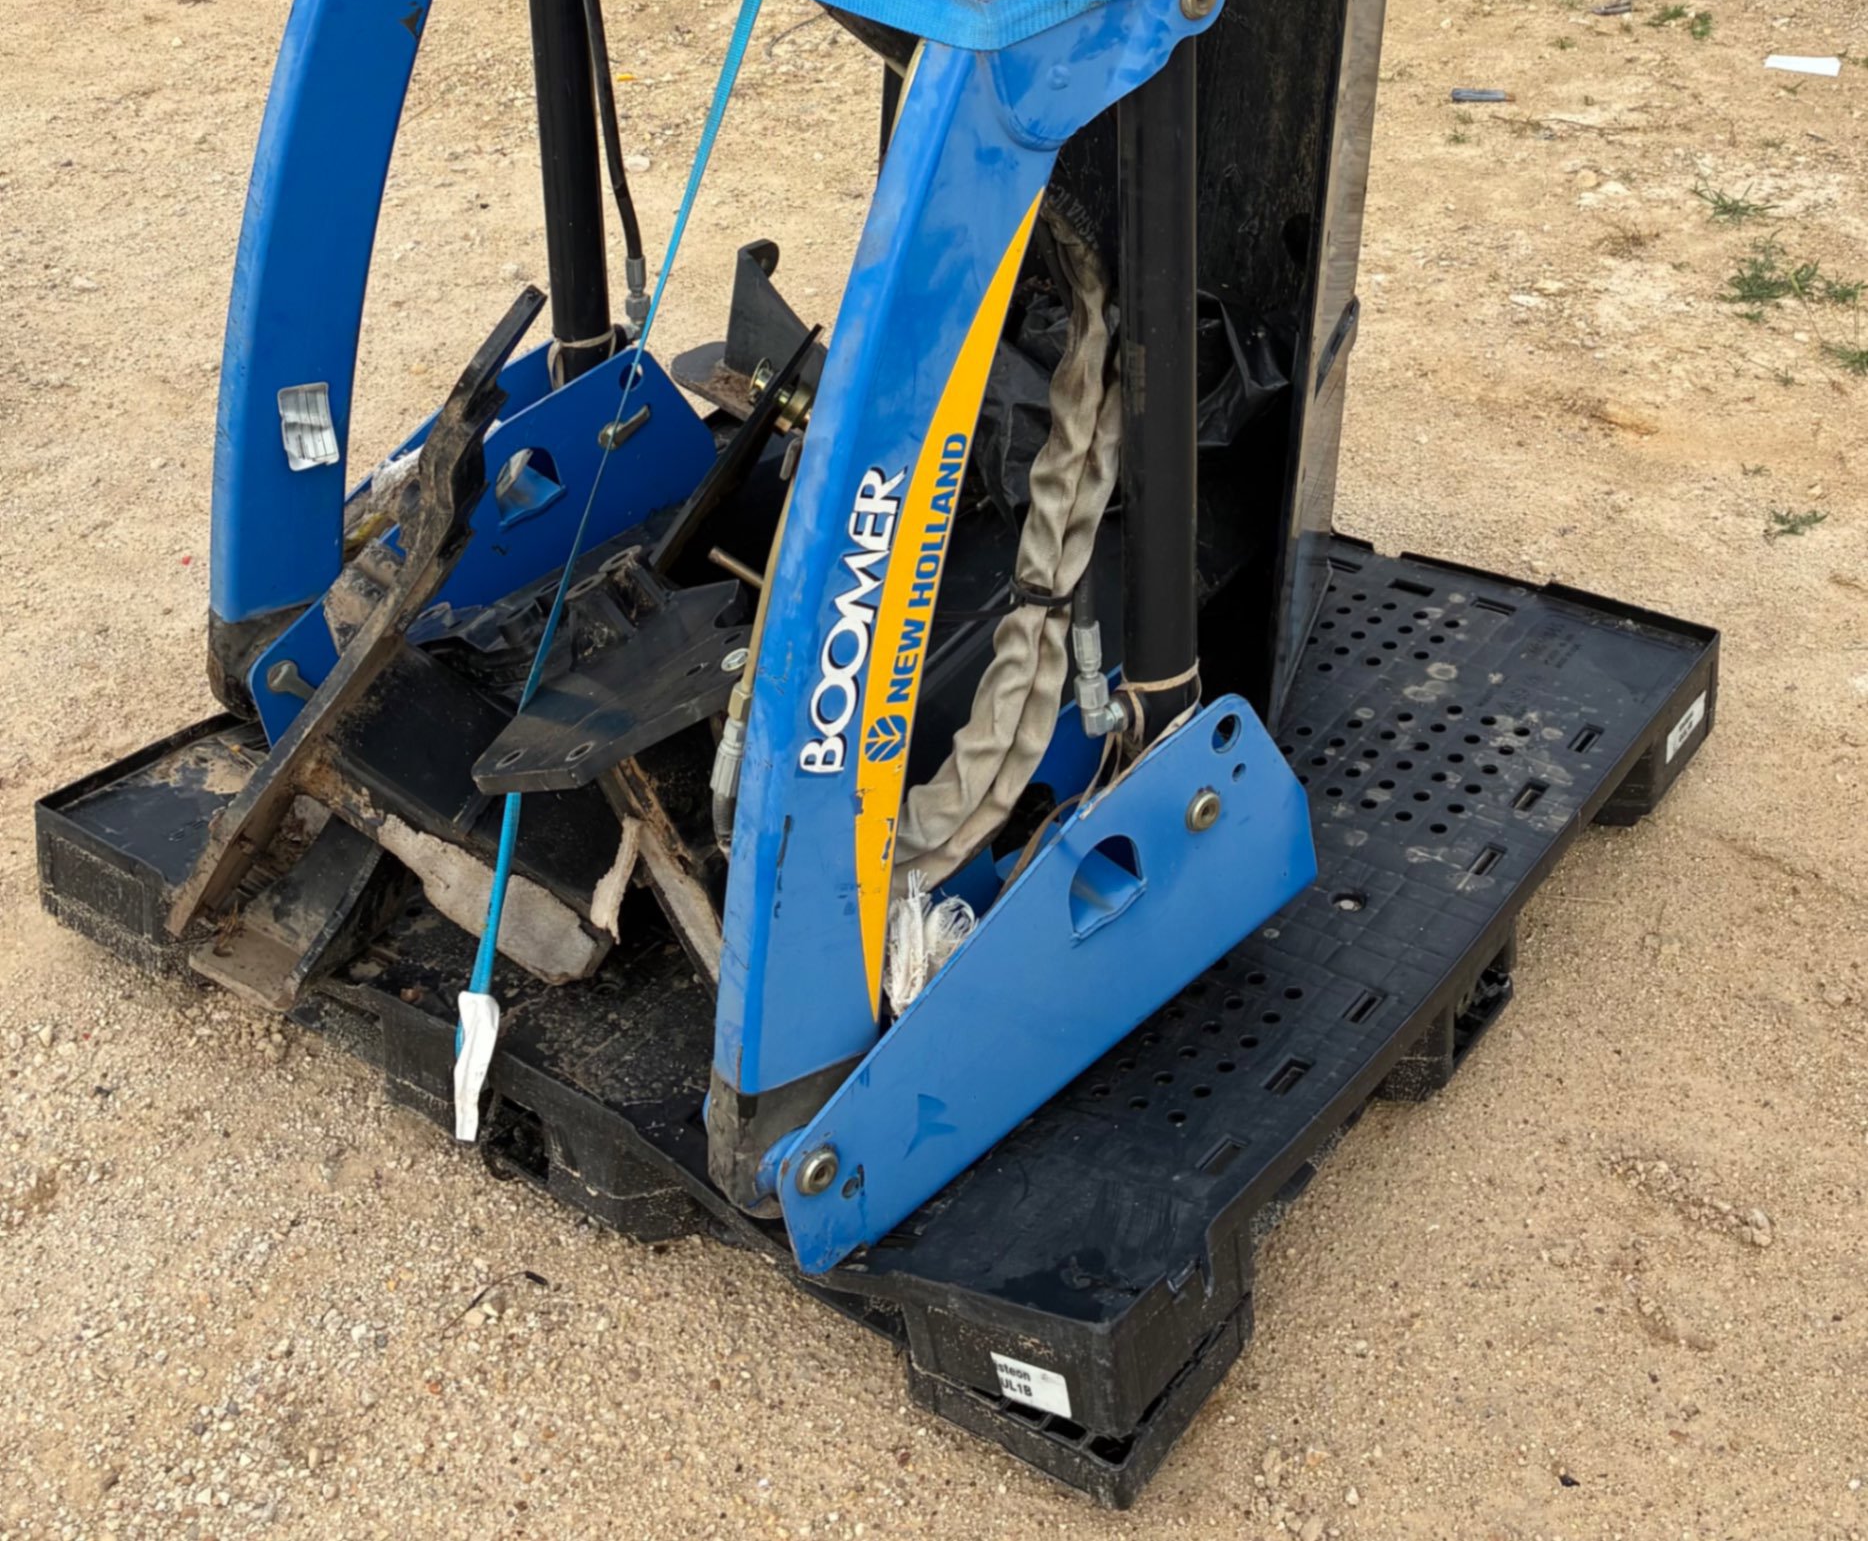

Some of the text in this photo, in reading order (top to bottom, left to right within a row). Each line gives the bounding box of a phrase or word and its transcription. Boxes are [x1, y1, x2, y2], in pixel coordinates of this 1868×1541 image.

[801, 466, 908, 773] BOOMER
[887, 432, 968, 704] NEW HOLLAND
